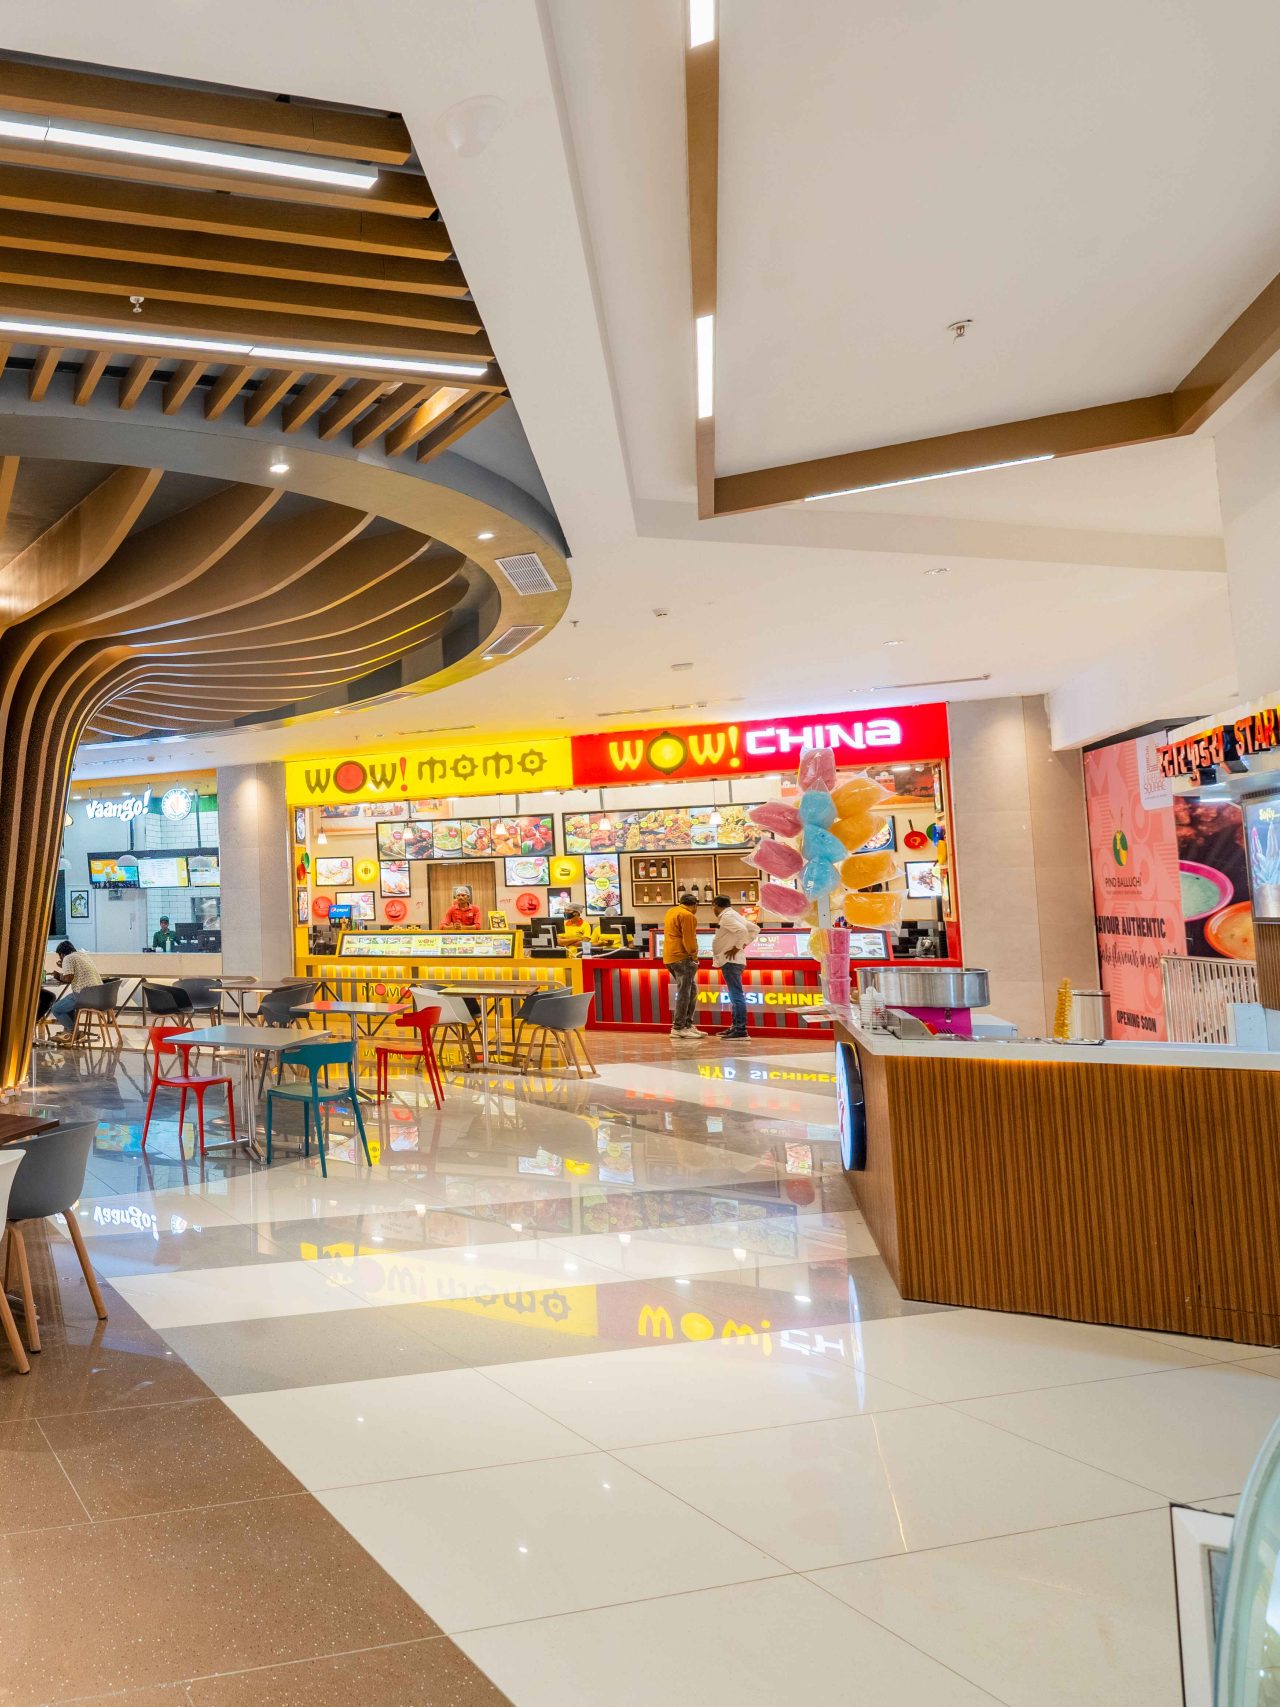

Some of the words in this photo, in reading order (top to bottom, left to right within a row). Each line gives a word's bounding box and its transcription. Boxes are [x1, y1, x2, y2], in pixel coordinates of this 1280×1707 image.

[1234, 704, 1280, 757] STAR
[86, 789, 152, 822] Vaango!
[1121, 917, 1166, 939] AUTHENTIC
[1116, 1009, 1140, 1028] OPENING
[1140, 1015, 1157, 1032] SOON
